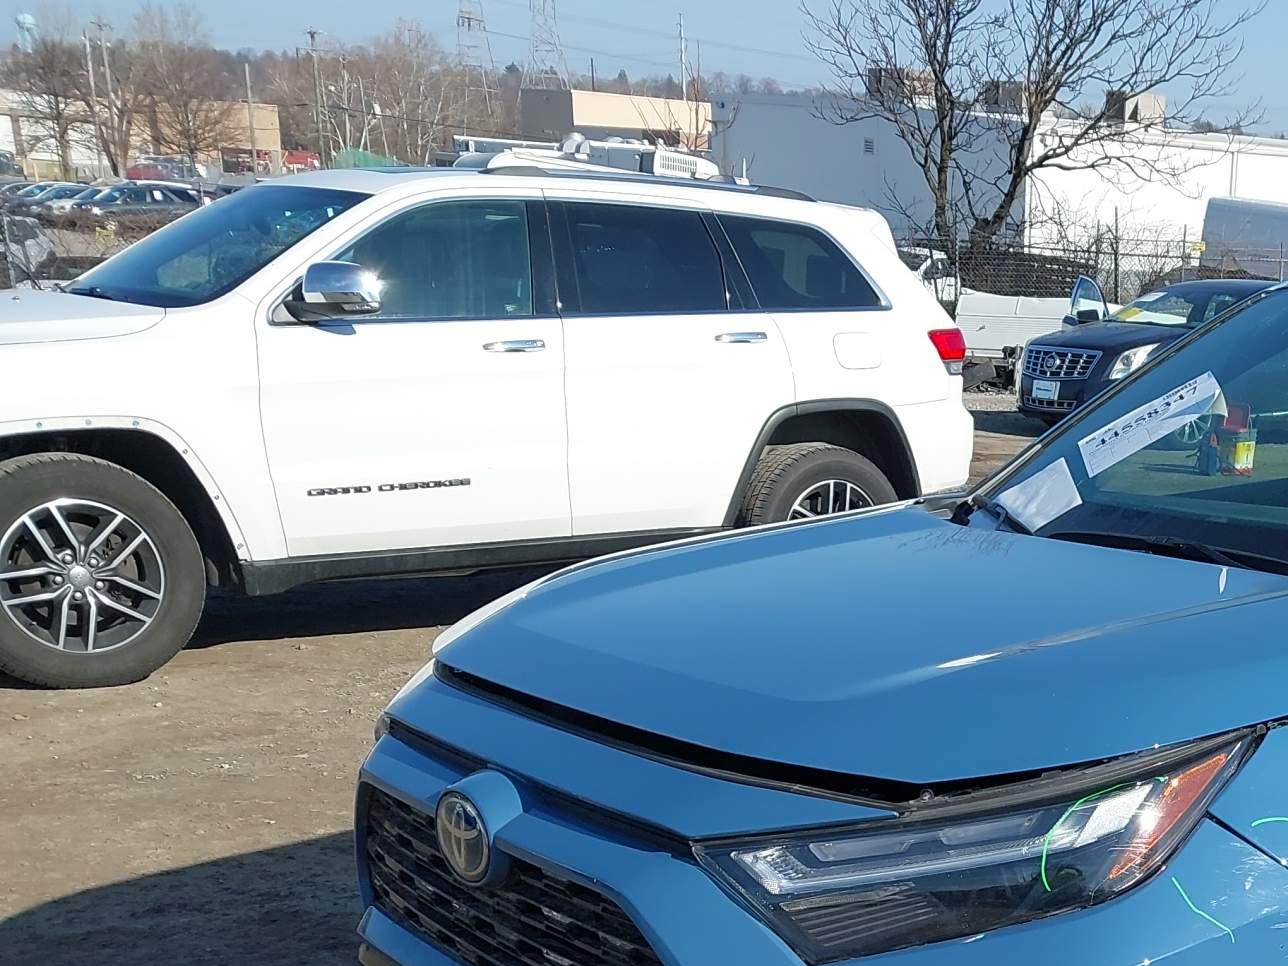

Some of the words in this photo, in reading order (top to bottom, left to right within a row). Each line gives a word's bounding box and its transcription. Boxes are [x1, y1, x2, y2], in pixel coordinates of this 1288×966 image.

[1095, 386, 1198, 448] 44558347
[307, 485, 371, 496] GRAND
[378, 478, 471, 492] CHEROKEE
